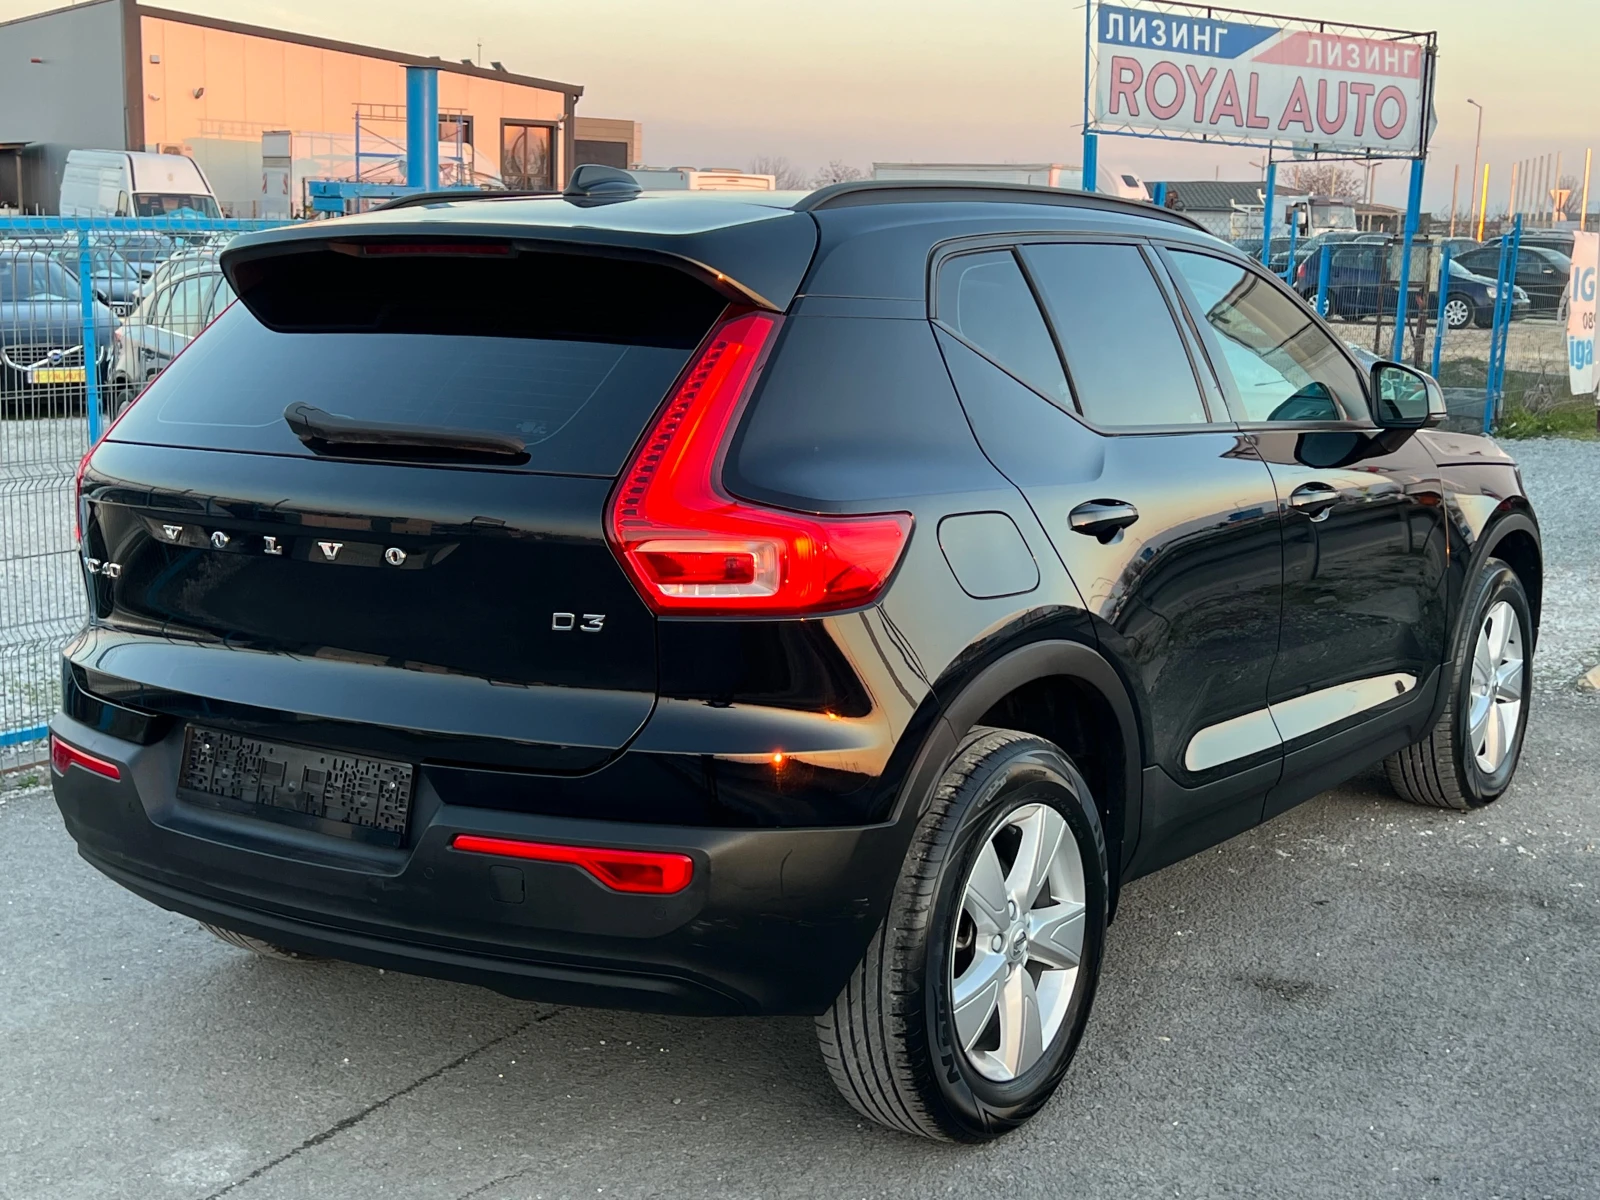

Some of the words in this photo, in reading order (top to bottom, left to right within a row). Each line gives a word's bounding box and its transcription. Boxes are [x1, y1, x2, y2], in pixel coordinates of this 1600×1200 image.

[1105, 13, 1228, 53] ЛИЗИНГ
[1306, 39, 1415, 74] ЛИЗИНГ
[1109, 55, 1269, 129] ROYAL
[1277, 76, 1408, 140] AUTO
[162, 523, 407, 566] VOLVO
[551, 612, 606, 632] D3
